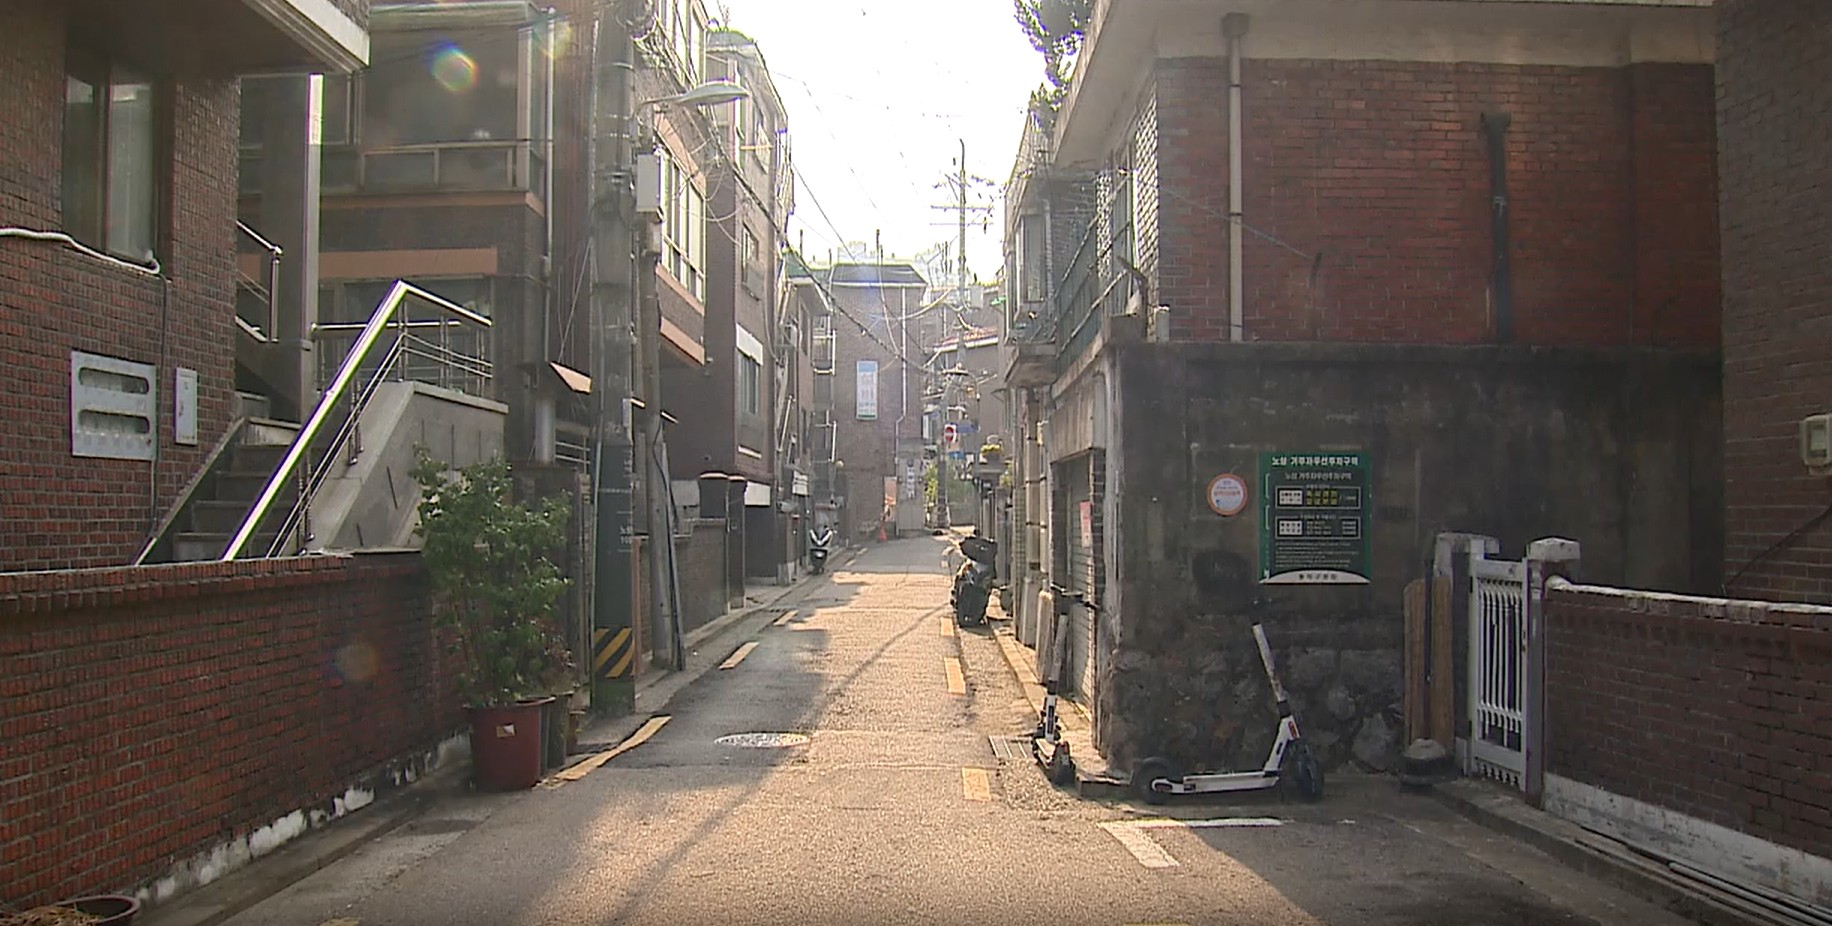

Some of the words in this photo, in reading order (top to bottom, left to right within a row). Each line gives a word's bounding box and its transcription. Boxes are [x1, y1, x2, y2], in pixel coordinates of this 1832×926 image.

[1272, 457, 1287, 465] 노상
[1291, 456, 1358, 466] 거주자우선주차구역
[1285, 472, 1298, 480] 노상
